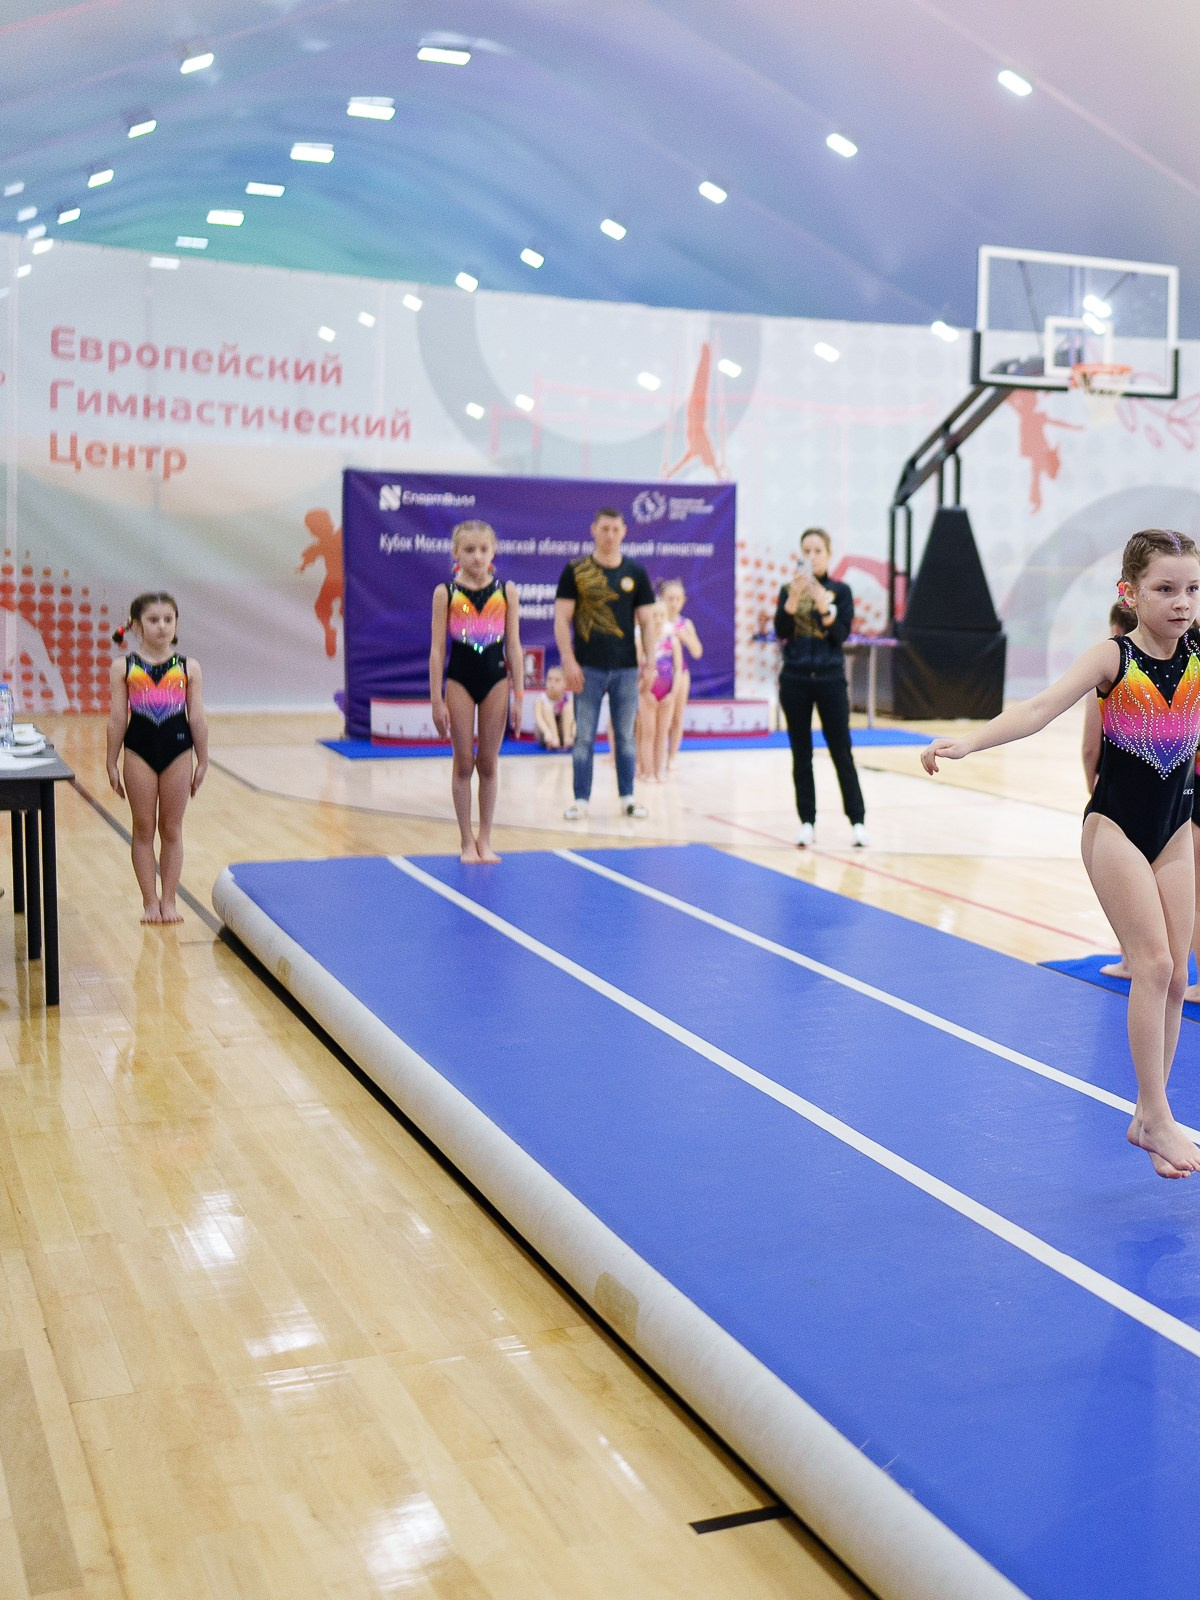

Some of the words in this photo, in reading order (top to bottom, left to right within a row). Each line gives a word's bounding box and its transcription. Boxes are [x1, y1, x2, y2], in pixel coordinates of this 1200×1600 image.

[50, 325, 344, 387] Европейский
[49, 379, 412, 442] Гимнастический
[49, 430, 188, 480] Центр
[380, 532, 413, 556] Кубок
[538, 536, 580, 556] области
